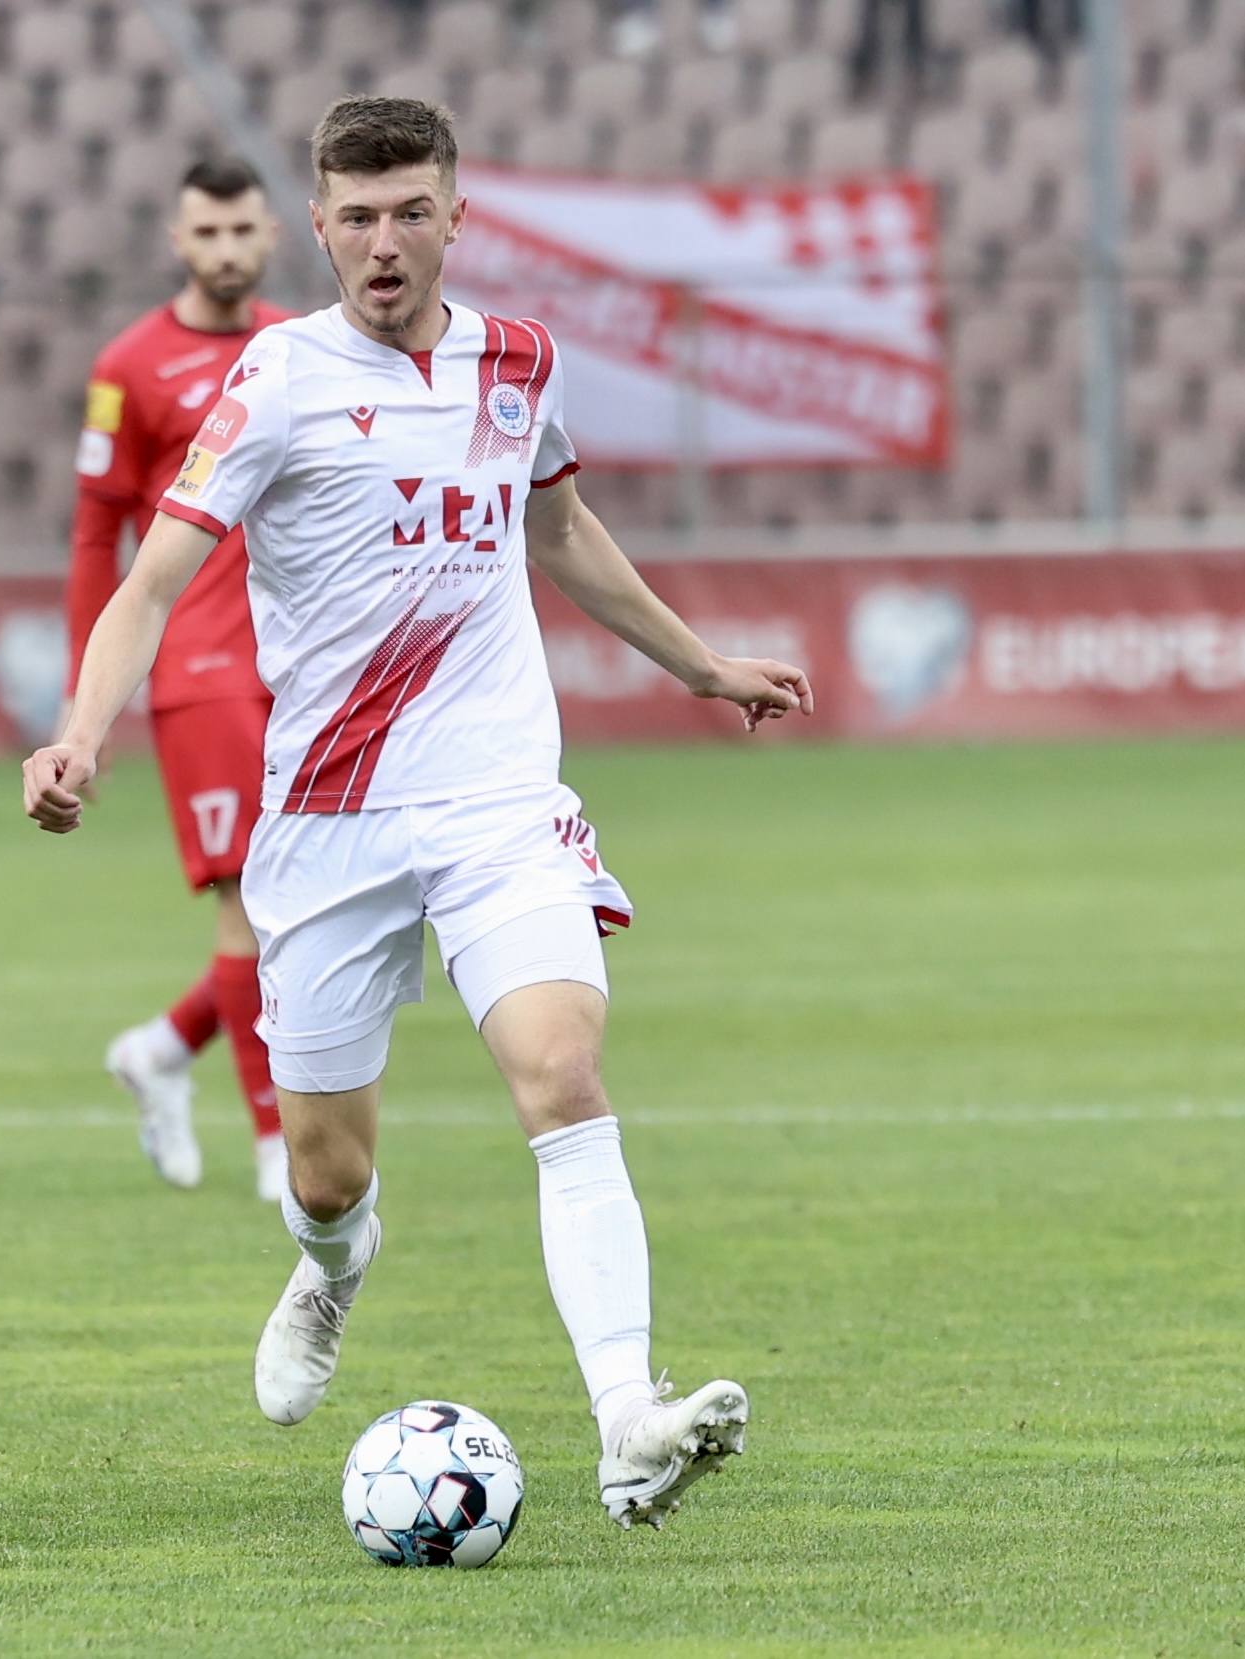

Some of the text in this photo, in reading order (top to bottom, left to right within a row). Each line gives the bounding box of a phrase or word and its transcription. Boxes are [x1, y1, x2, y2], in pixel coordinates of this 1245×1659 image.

[203, 412, 235, 439] tel
[176, 477, 200, 494] ART
[427, 563, 507, 577] ABRAHAM
[392, 579, 462, 593] GROUP
